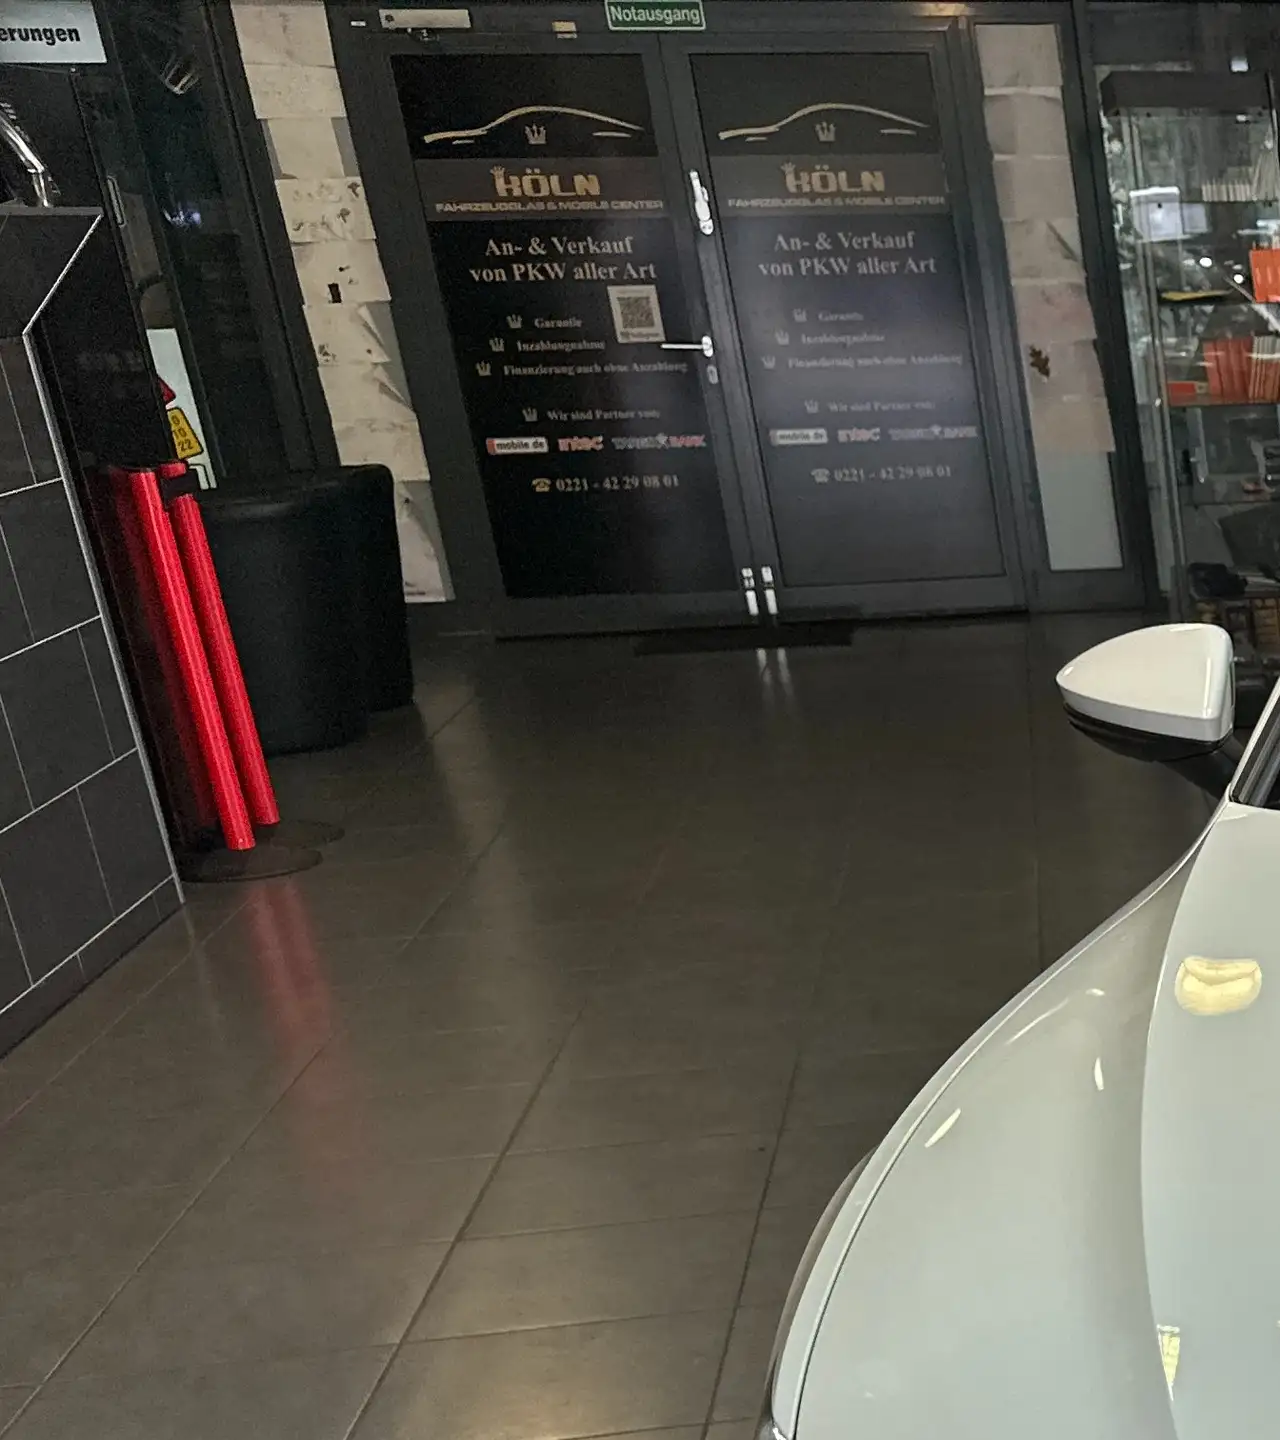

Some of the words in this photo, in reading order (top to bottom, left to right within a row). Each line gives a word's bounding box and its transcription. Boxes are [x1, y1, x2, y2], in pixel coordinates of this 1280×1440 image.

[609, 5, 701, 25] Notausgang
[491, 167, 601, 197] KÖLN
[784, 165, 886, 194] KÖLN
[611, 198, 664, 211] CENTER
[484, 238, 523, 257] An-
[528, 237, 547, 256] &
[551, 236, 634, 255] Verkauf
[774, 234, 810, 251] An-
[815, 232, 833, 250] &
[837, 231, 916, 249] Verkauf
[469, 267, 508, 282] von
[511, 262, 567, 282] PKW
[573, 262, 618, 281] aller
[622, 262, 658, 280] Art
[758, 262, 795, 277] von
[799, 257, 852, 277] PKW
[855, 256, 900, 275] aller
[903, 256, 938, 274] Art
[555, 476, 590, 492] 0221
[602, 476, 621, 490] 42
[622, 475, 640, 490] 29
[662, 474, 680, 488] 01
